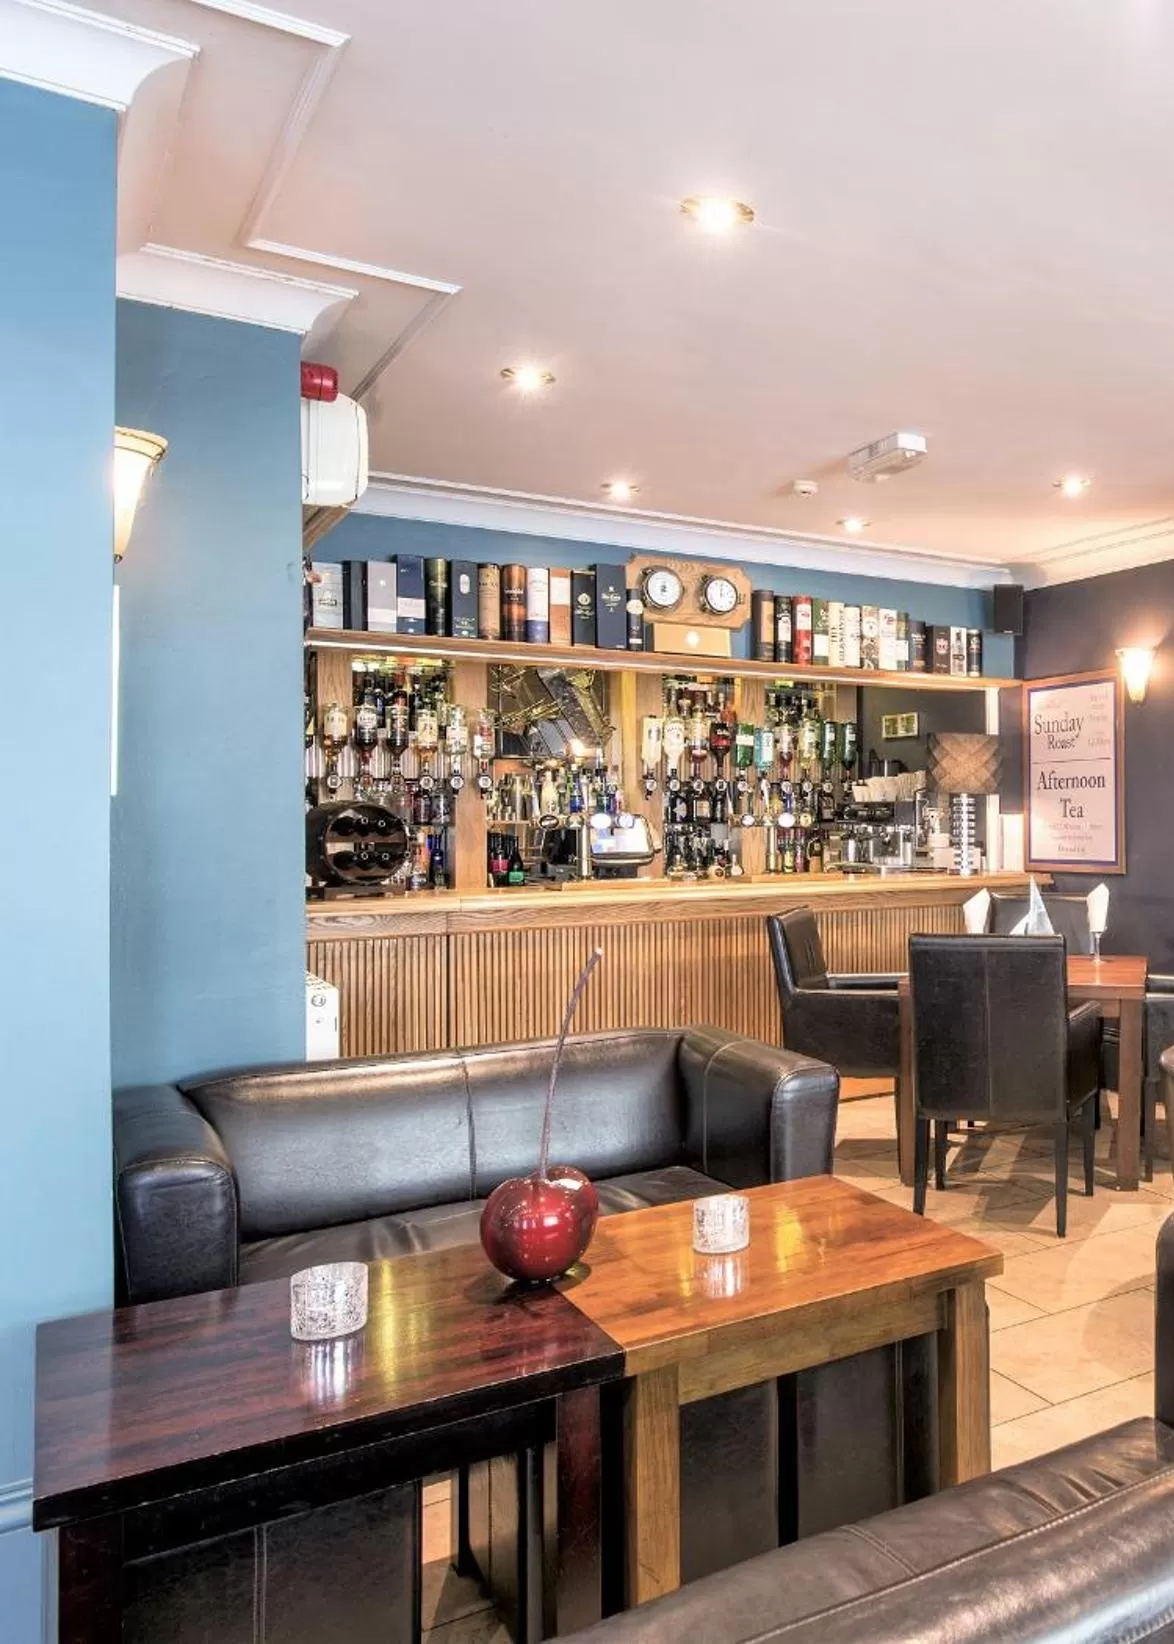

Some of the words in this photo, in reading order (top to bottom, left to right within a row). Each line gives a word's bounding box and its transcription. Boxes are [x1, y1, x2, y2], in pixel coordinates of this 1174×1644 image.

[1034, 711, 1084, 738] Sunday
[1047, 734, 1076, 750] Roast
[1036, 770, 1106, 790] Afternoon
[1059, 797, 1085, 818] Tea
